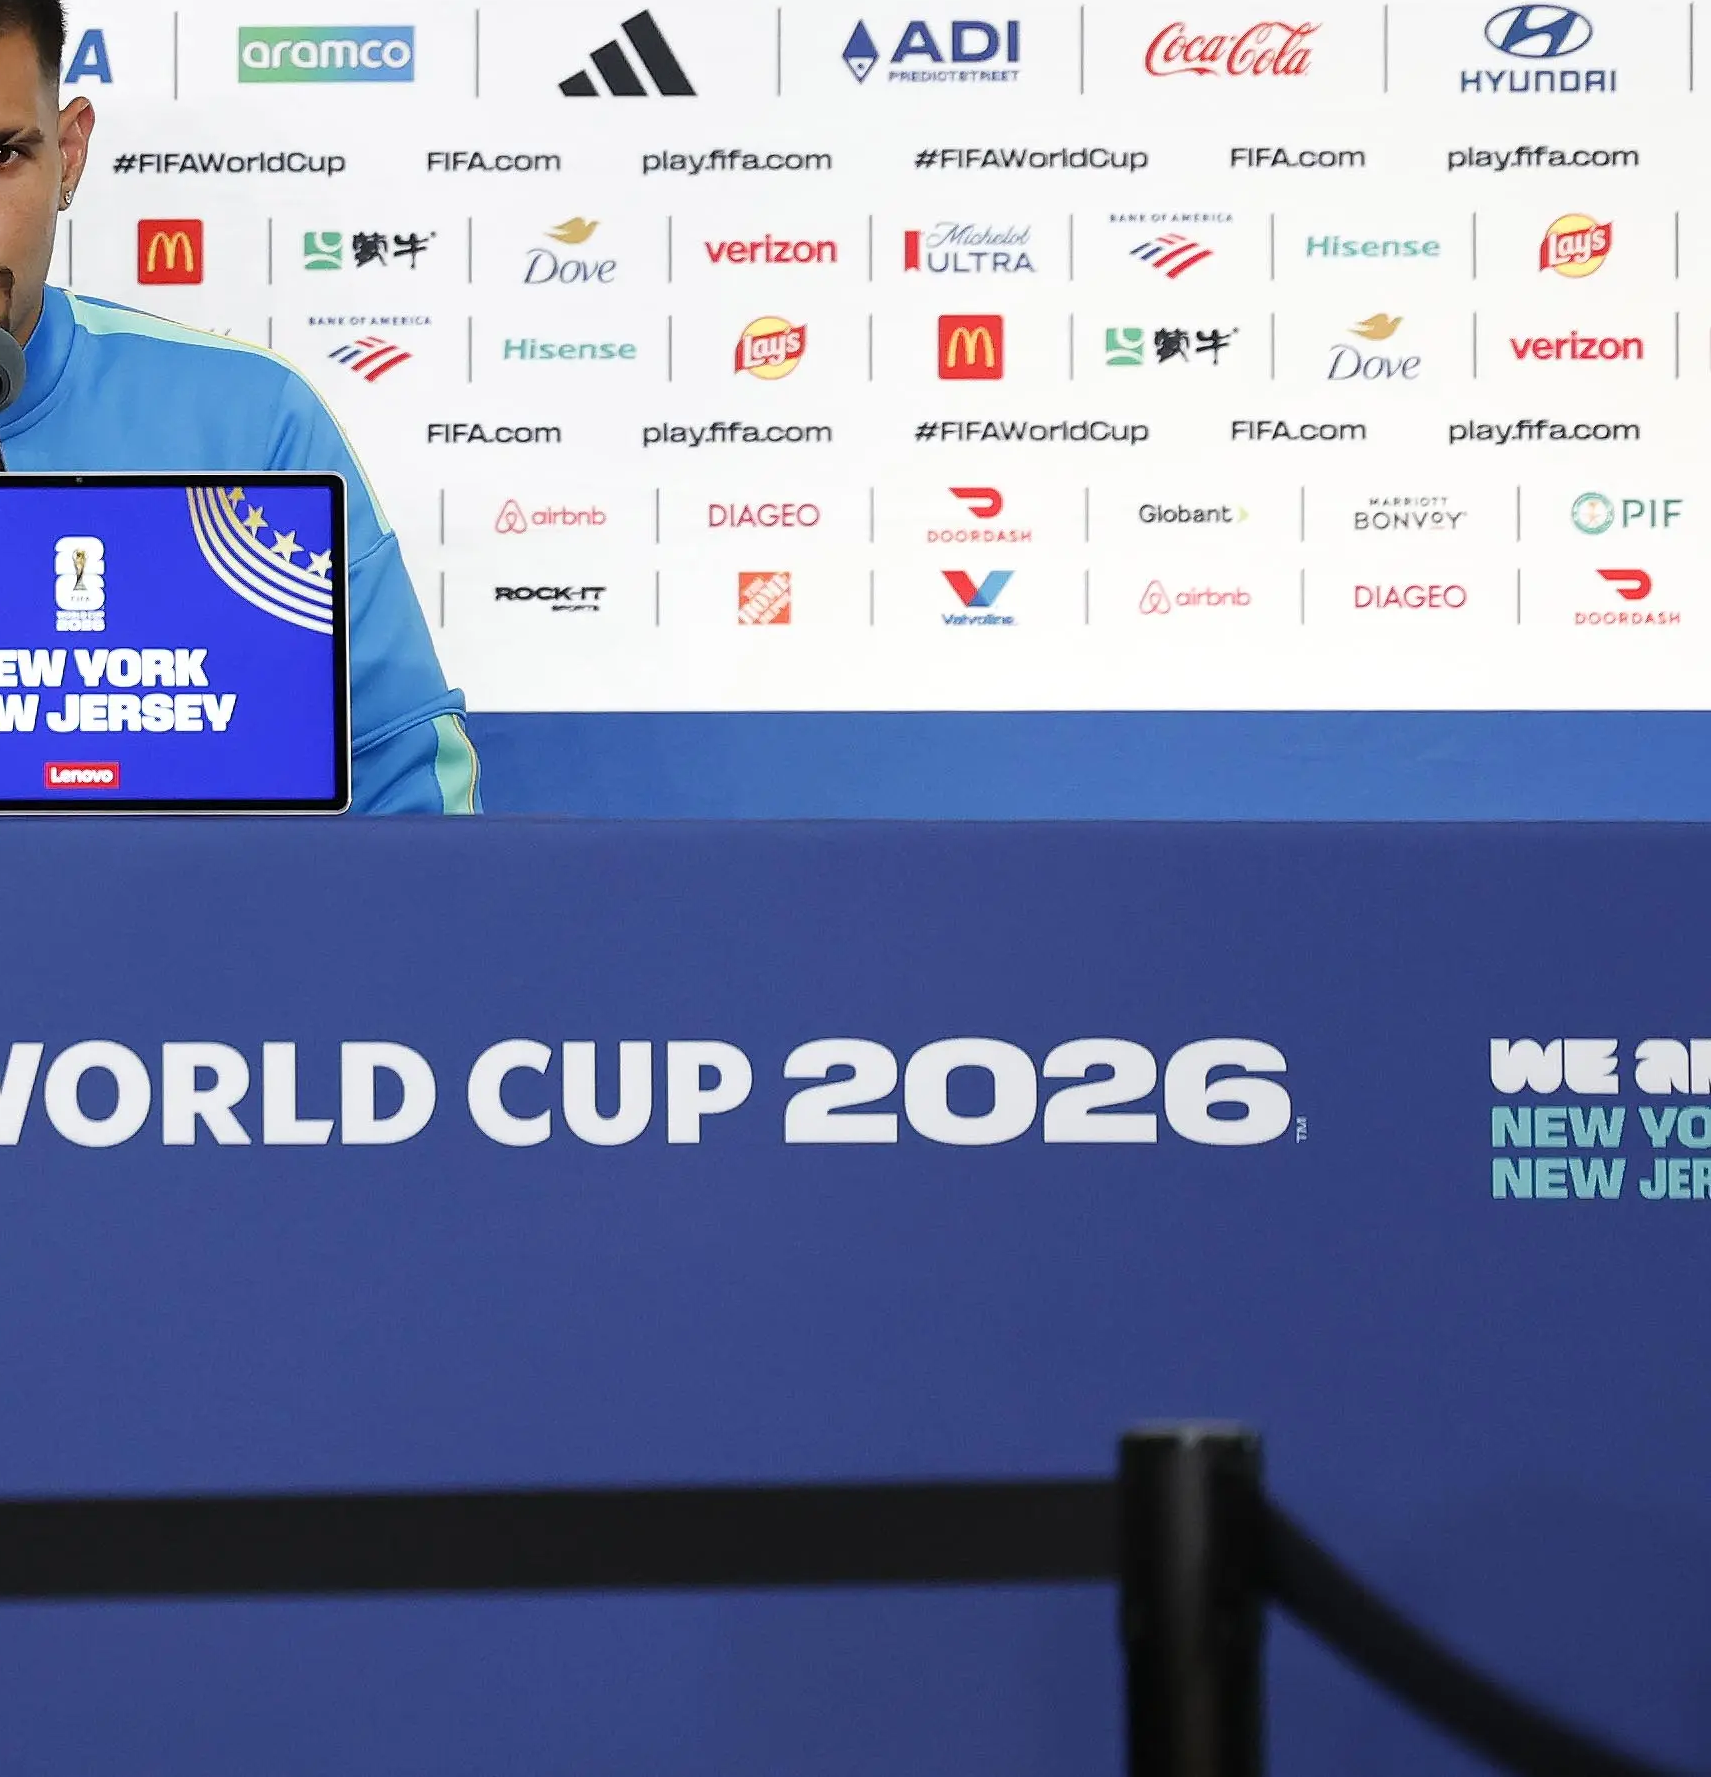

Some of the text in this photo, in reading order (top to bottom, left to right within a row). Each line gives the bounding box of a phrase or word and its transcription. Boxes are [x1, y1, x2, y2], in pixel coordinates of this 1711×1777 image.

[1460, 69, 1617, 94] HYUNDAI
[112, 150, 346, 178] #FIFAWorldCup
[642, 149, 833, 176] play.fifa.com
[913, 147, 1149, 174] #FIFAWorldCup
[1230, 147, 1366, 169] FIFA.com
[1447, 145, 1640, 173] play.fifa.com
[1306, 236, 1440, 257] Hisense
[1547, 225, 1607, 265] Lay's
[927, 250, 1034, 273] ULTRA
[1509, 329, 1644, 361] verizon
[1327, 350, 1421, 380] Dove
[427, 423, 562, 444] FIFA.com
[914, 420, 1149, 446] #FIFAWorldCup
[1448, 418, 1641, 446] play.fifa.com
[532, 508, 607, 526] airbnb
[708, 503, 820, 528] DIAGEO
[1138, 503, 1233, 524] Globant
[1354, 511, 1462, 530] BONVOY
[1622, 498, 1684, 529] PIF
[494, 586, 607, 602] ROCK-IT
[1575, 611, 1680, 625] DOORDASH
[73, 648, 209, 688] YORK
[45, 693, 237, 733] JERSEY
[50, 767, 113, 785] Lenovo
[1490, 1038, 1619, 1094] WE
[467, 1039, 753, 1147] CUP
[783, 1037, 1291, 1146] 2026
[1491, 1105, 1711, 1149] NEW YO
[1492, 1157, 1626, 1199] NEW
